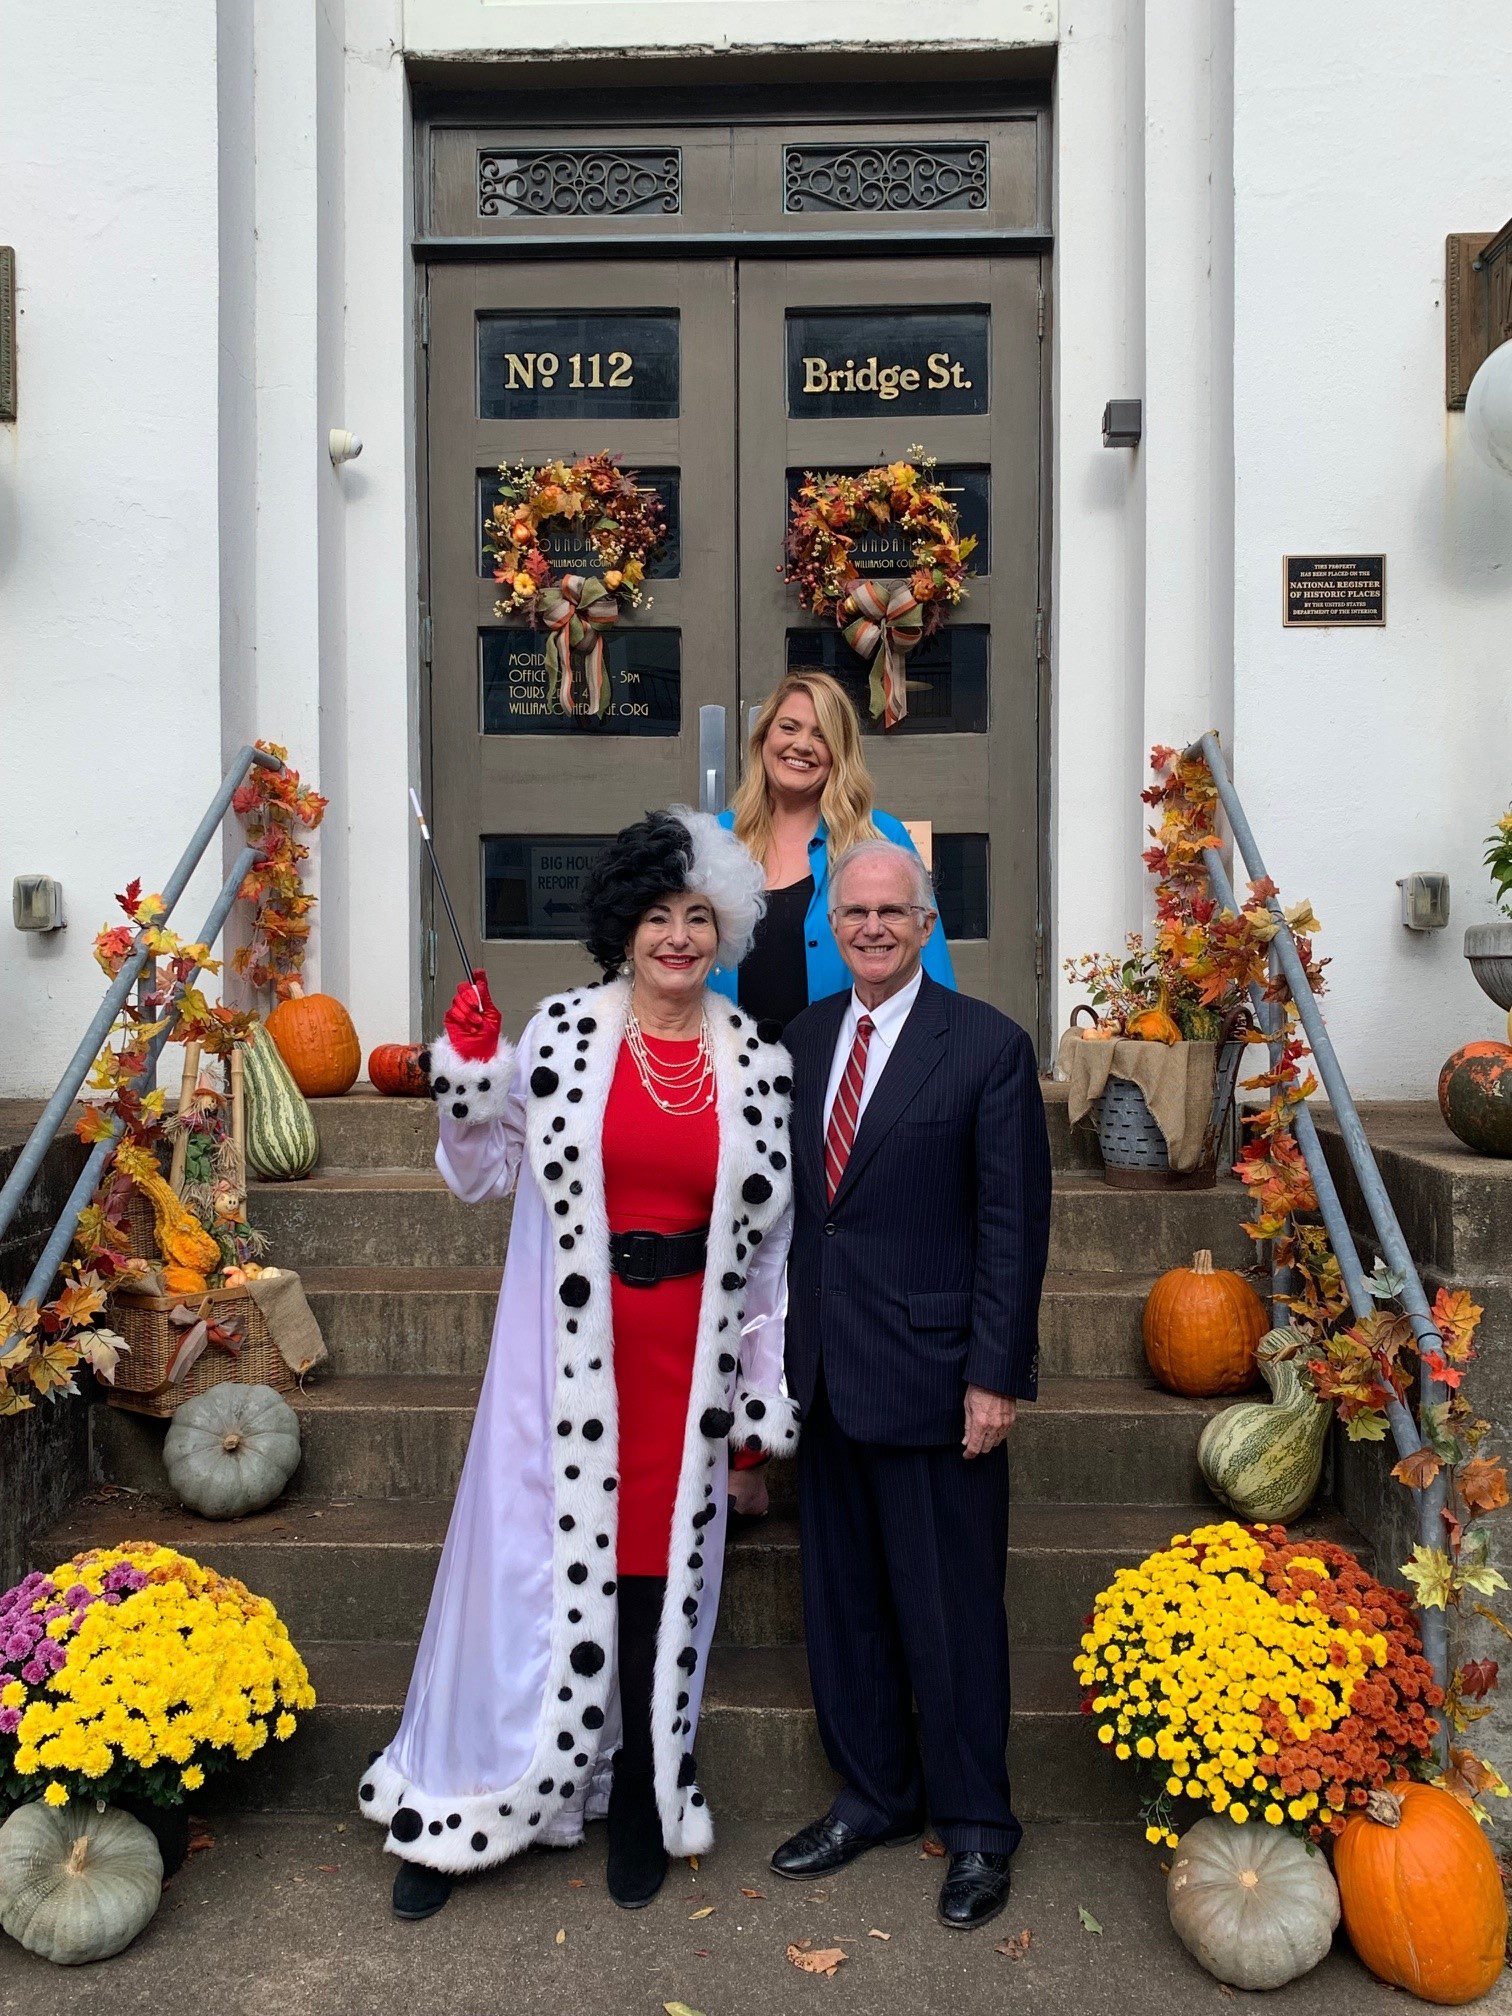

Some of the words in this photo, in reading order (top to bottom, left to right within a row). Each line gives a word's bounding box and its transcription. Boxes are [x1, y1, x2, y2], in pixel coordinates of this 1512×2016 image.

[568, 351, 634, 388] 112
[802, 356, 920, 400] Bridge
[927, 352, 973, 390] St.
[854, 559, 894, 569] WILLIAMSON
[1290, 581, 1336, 589] NATIONAL
[1337, 581, 1381, 589] REGISTER
[1290, 591, 1302, 599] OF
[1303, 591, 1347, 599] HISTORIC
[1347, 591, 1381, 599] PLACES
[508, 653, 546, 667] MOND
[508, 669, 546, 683] OFFICE
[508, 685, 546, 699] TOURS
[541, 856, 563, 871] BIG
[566, 856, 594, 871] HOU
[538, 875, 580, 890] REPORT
